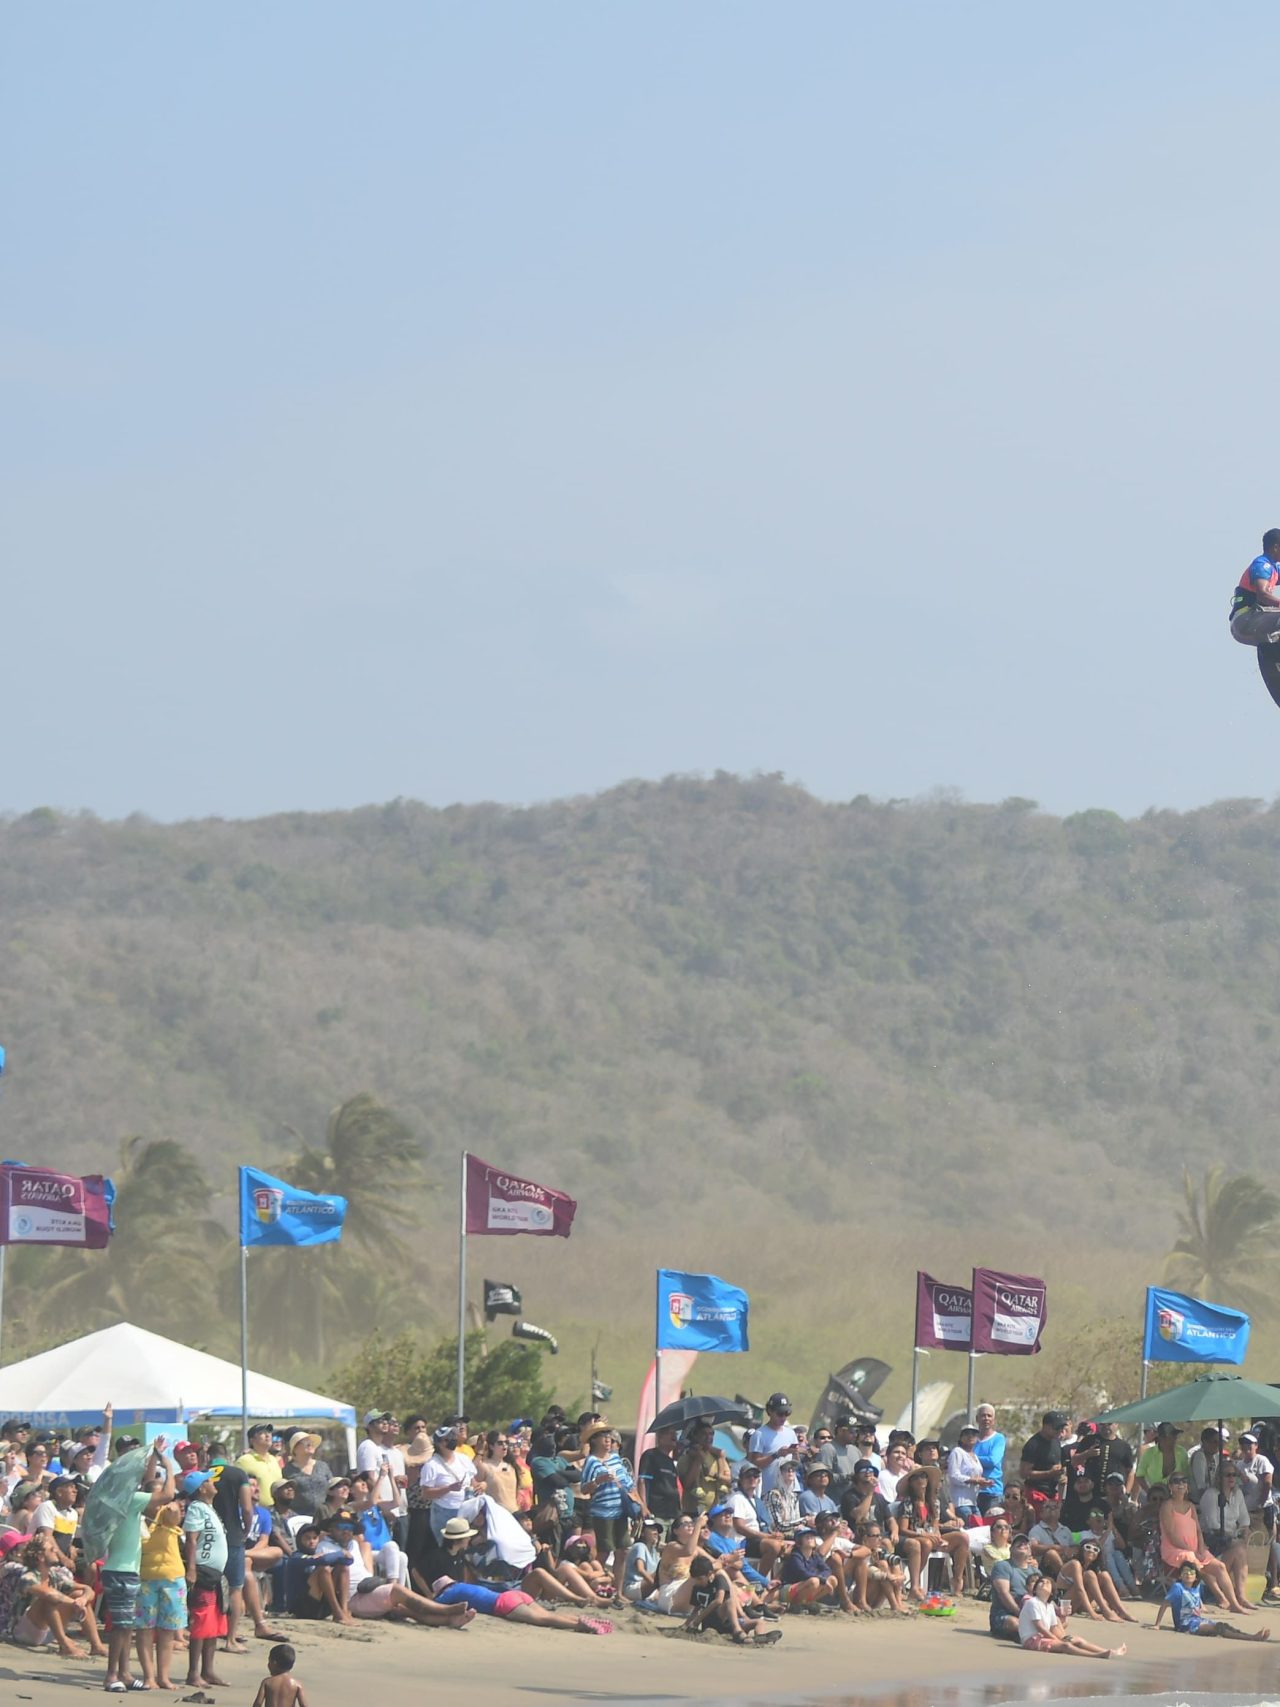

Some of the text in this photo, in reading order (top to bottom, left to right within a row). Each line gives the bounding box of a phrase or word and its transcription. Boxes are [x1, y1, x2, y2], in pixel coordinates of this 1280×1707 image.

[939, 1293, 972, 1307] QATA
[1001, 1292, 1039, 1308] QATAR
[1011, 1304, 1038, 1315] AIRWAYS
